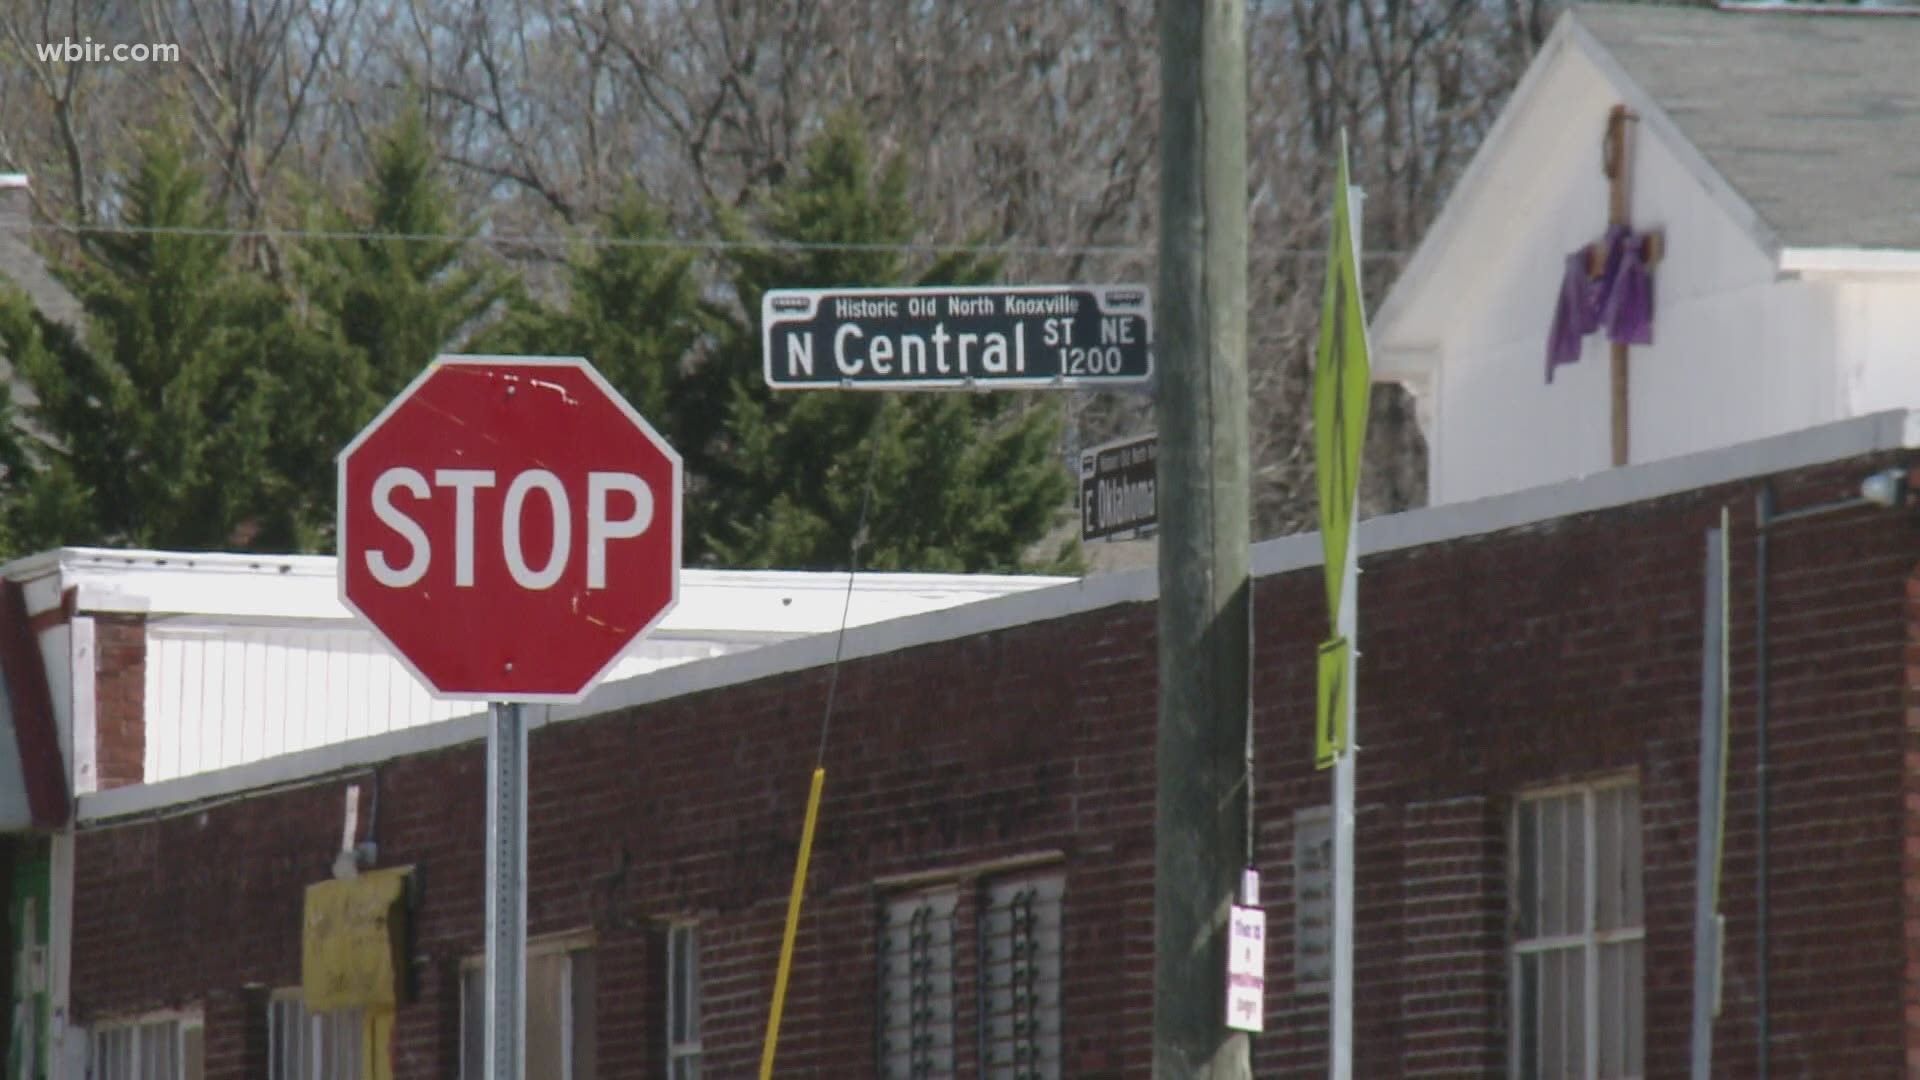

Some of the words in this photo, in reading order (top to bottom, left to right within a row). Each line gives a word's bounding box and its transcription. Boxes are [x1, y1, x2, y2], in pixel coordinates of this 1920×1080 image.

[836, 297, 898, 318] Historic
[908, 296, 936, 316] Old
[948, 296, 994, 316] North
[1005, 295, 1079, 315] Knoxville
[787, 332, 813, 376] N
[834, 321, 1025, 376] Central
[1043, 317, 1075, 346] ST
[1101, 317, 1135, 344] NE
[1059, 347, 1122, 375] 1200
[364, 466, 655, 591] STOP
[1086, 490, 1095, 532] E
[1098, 475, 1155, 529] Oklahoma
